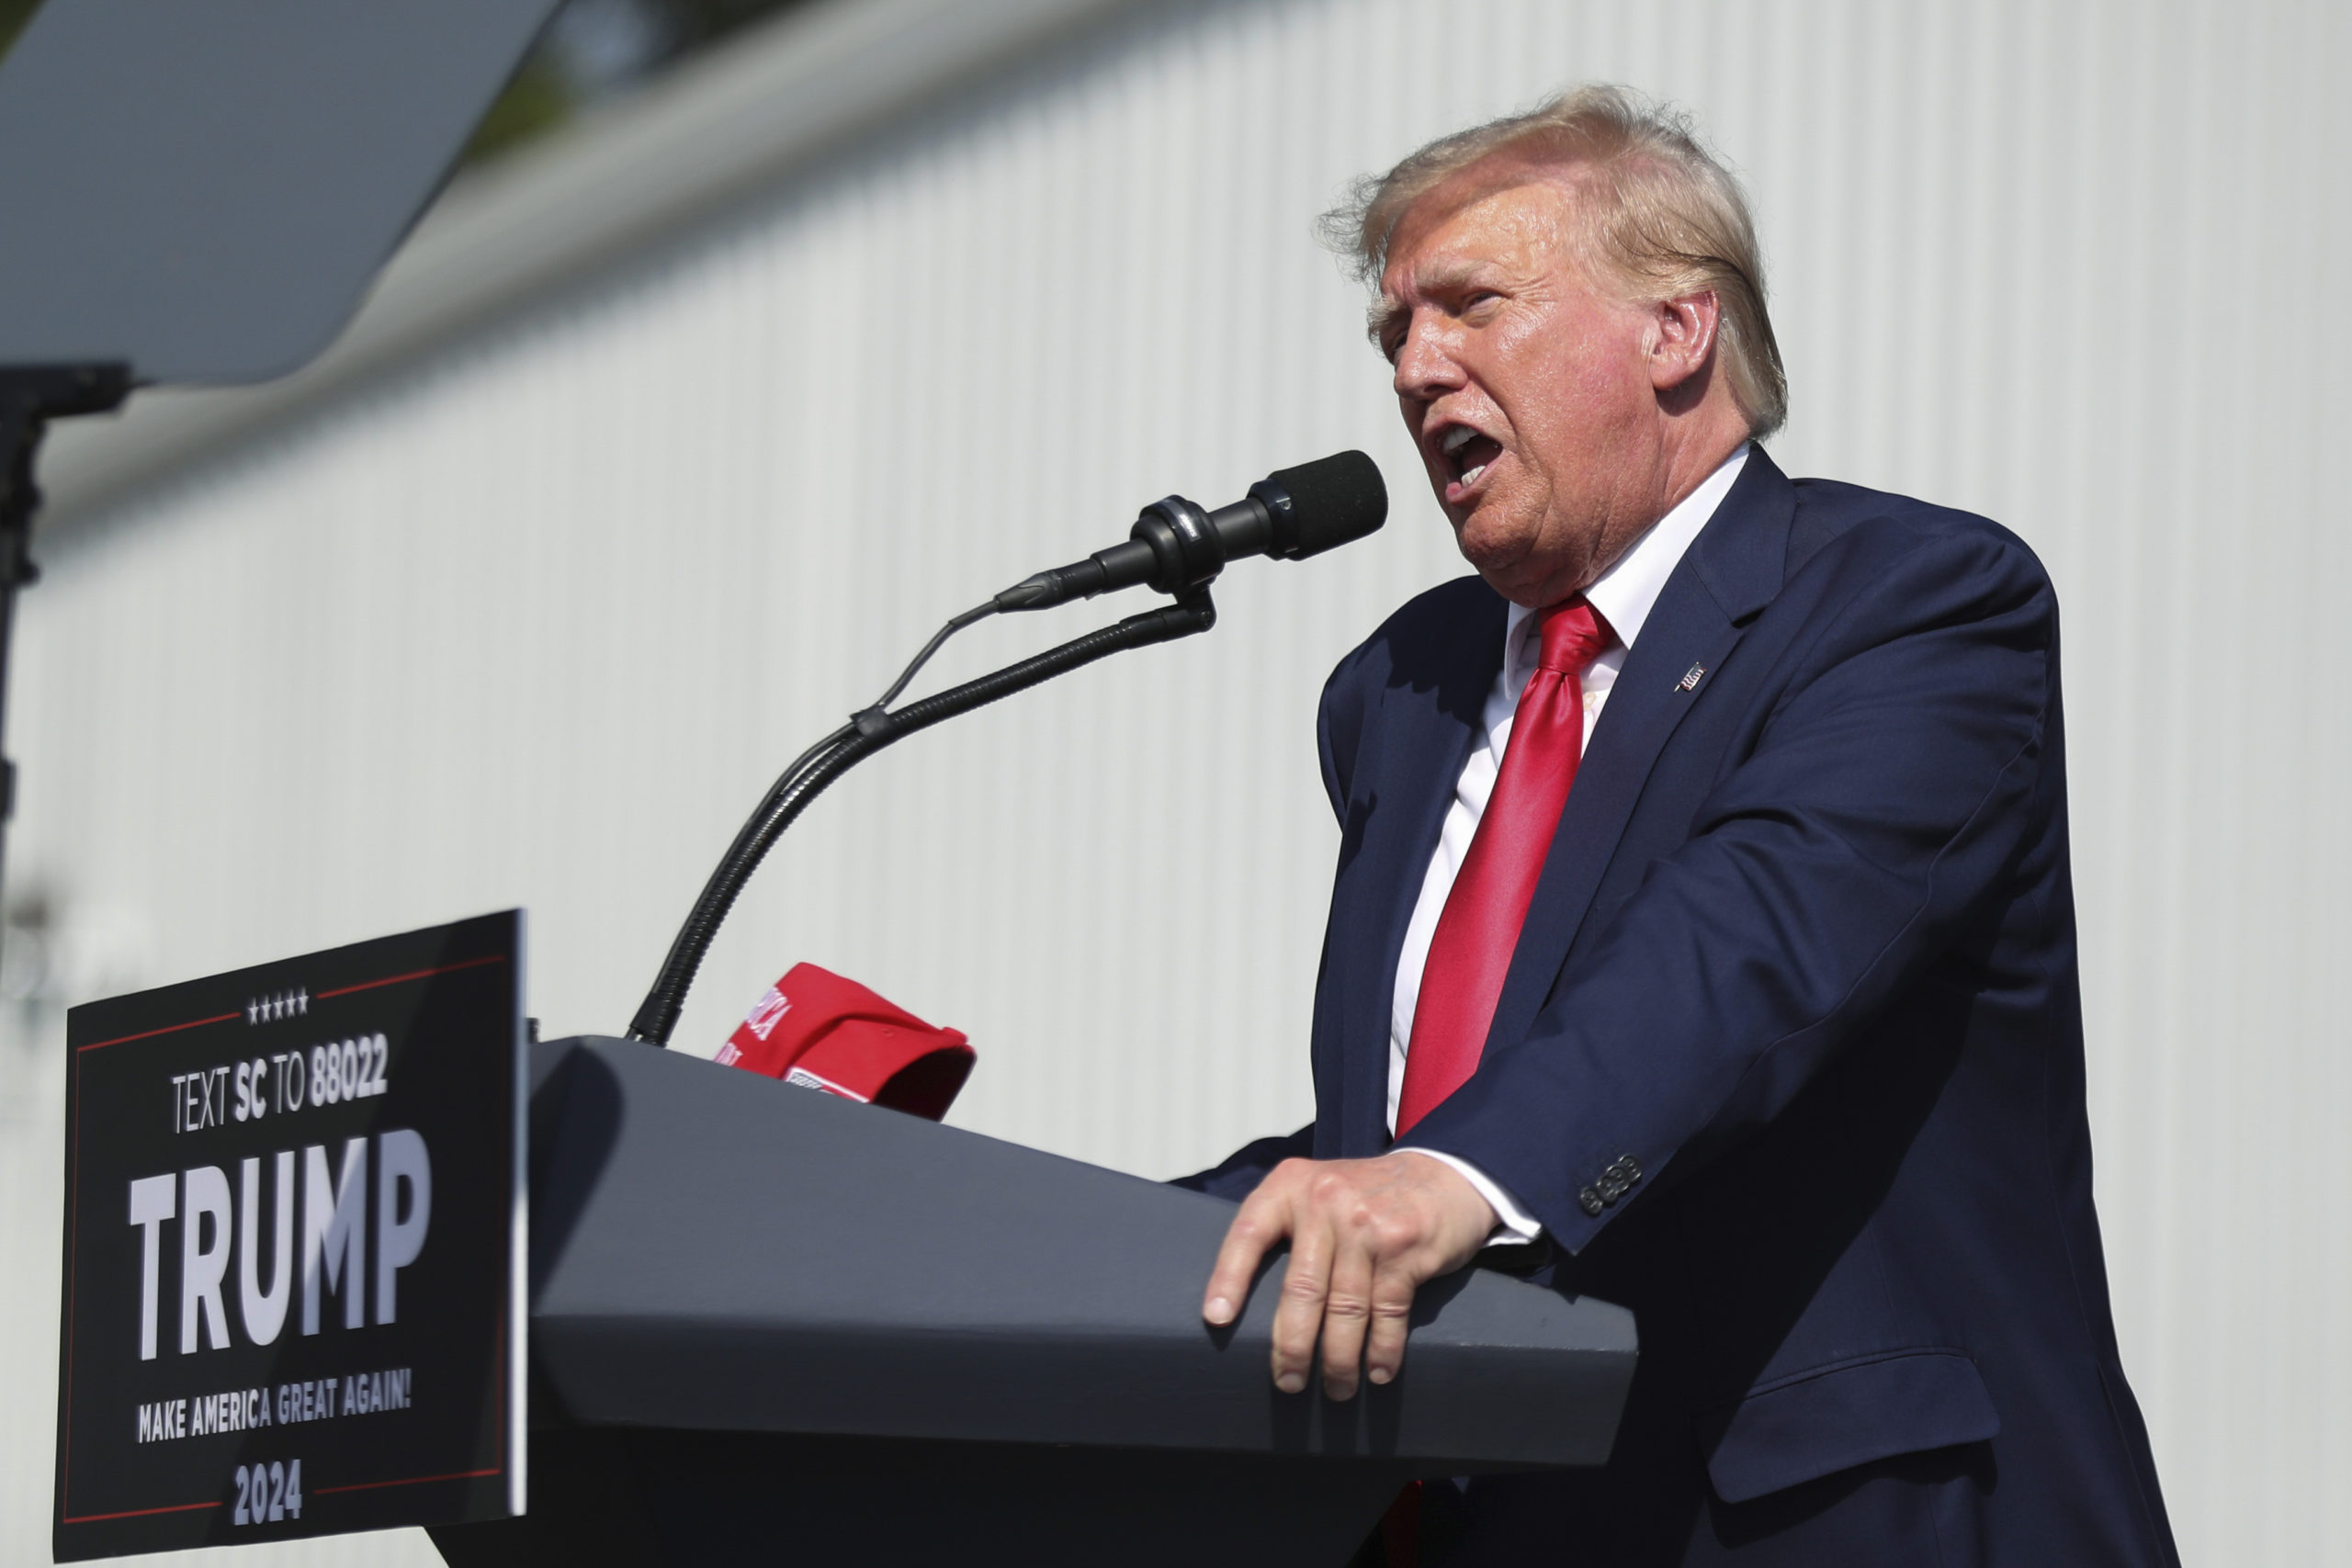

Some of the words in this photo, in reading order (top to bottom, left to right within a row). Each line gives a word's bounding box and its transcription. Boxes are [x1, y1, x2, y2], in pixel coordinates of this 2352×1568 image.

[171, 1066, 232, 1134] TEXT
[233, 1057, 268, 1122] SC
[272, 1050, 306, 1114] TO
[309, 1032, 389, 1108] 88022
[128, 1128, 432, 1361] TRUMP
[137, 1398, 187, 1444] MAKE
[190, 1387, 272, 1437] AMERICA
[277, 1378, 337, 1427] GREAT
[343, 1367, 413, 1417] AGAIN!
[233, 1459, 303, 1526] 2024
